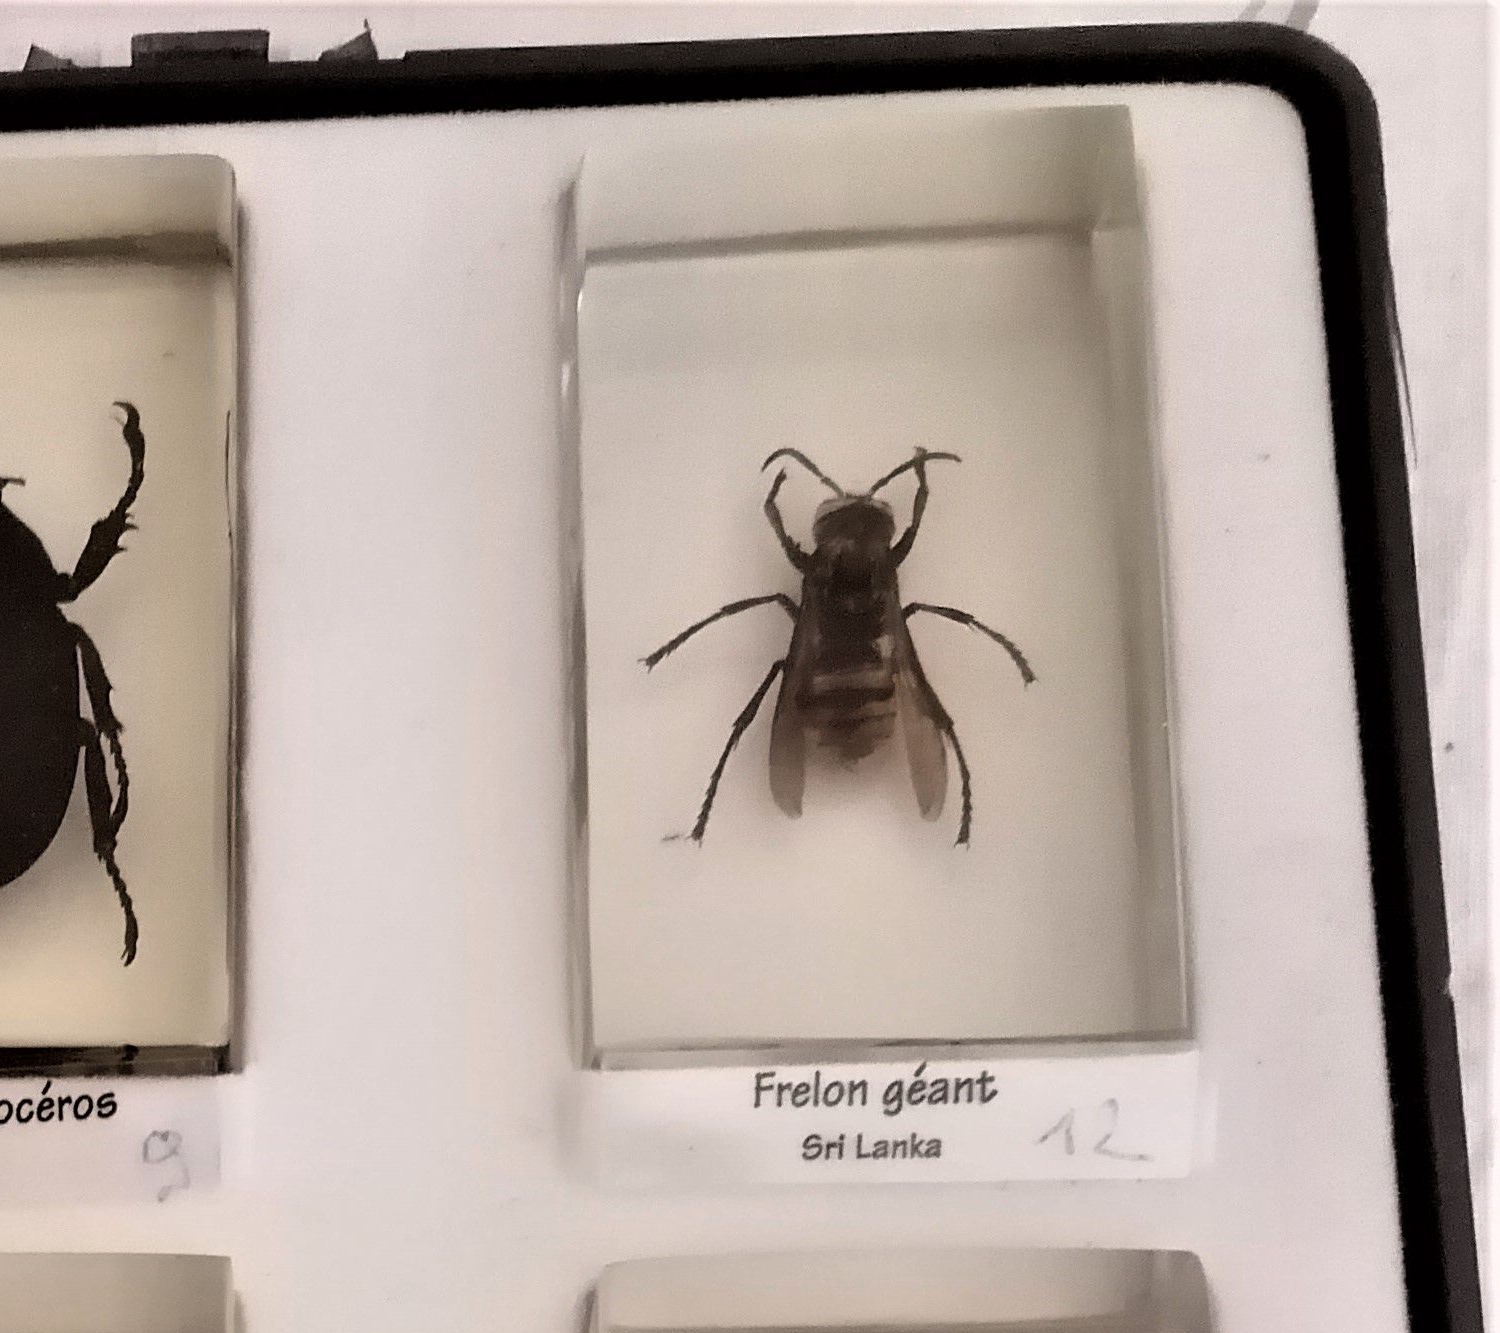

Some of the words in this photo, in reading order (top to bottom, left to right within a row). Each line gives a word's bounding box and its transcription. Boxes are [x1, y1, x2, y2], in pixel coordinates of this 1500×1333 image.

[753, 1071, 868, 1109] Frelon
[881, 1062, 999, 1117] géant
[801, 1133, 844, 1160] Sri
[855, 1132, 943, 1159] Lanka
[1035, 1097, 1154, 1162] 12
